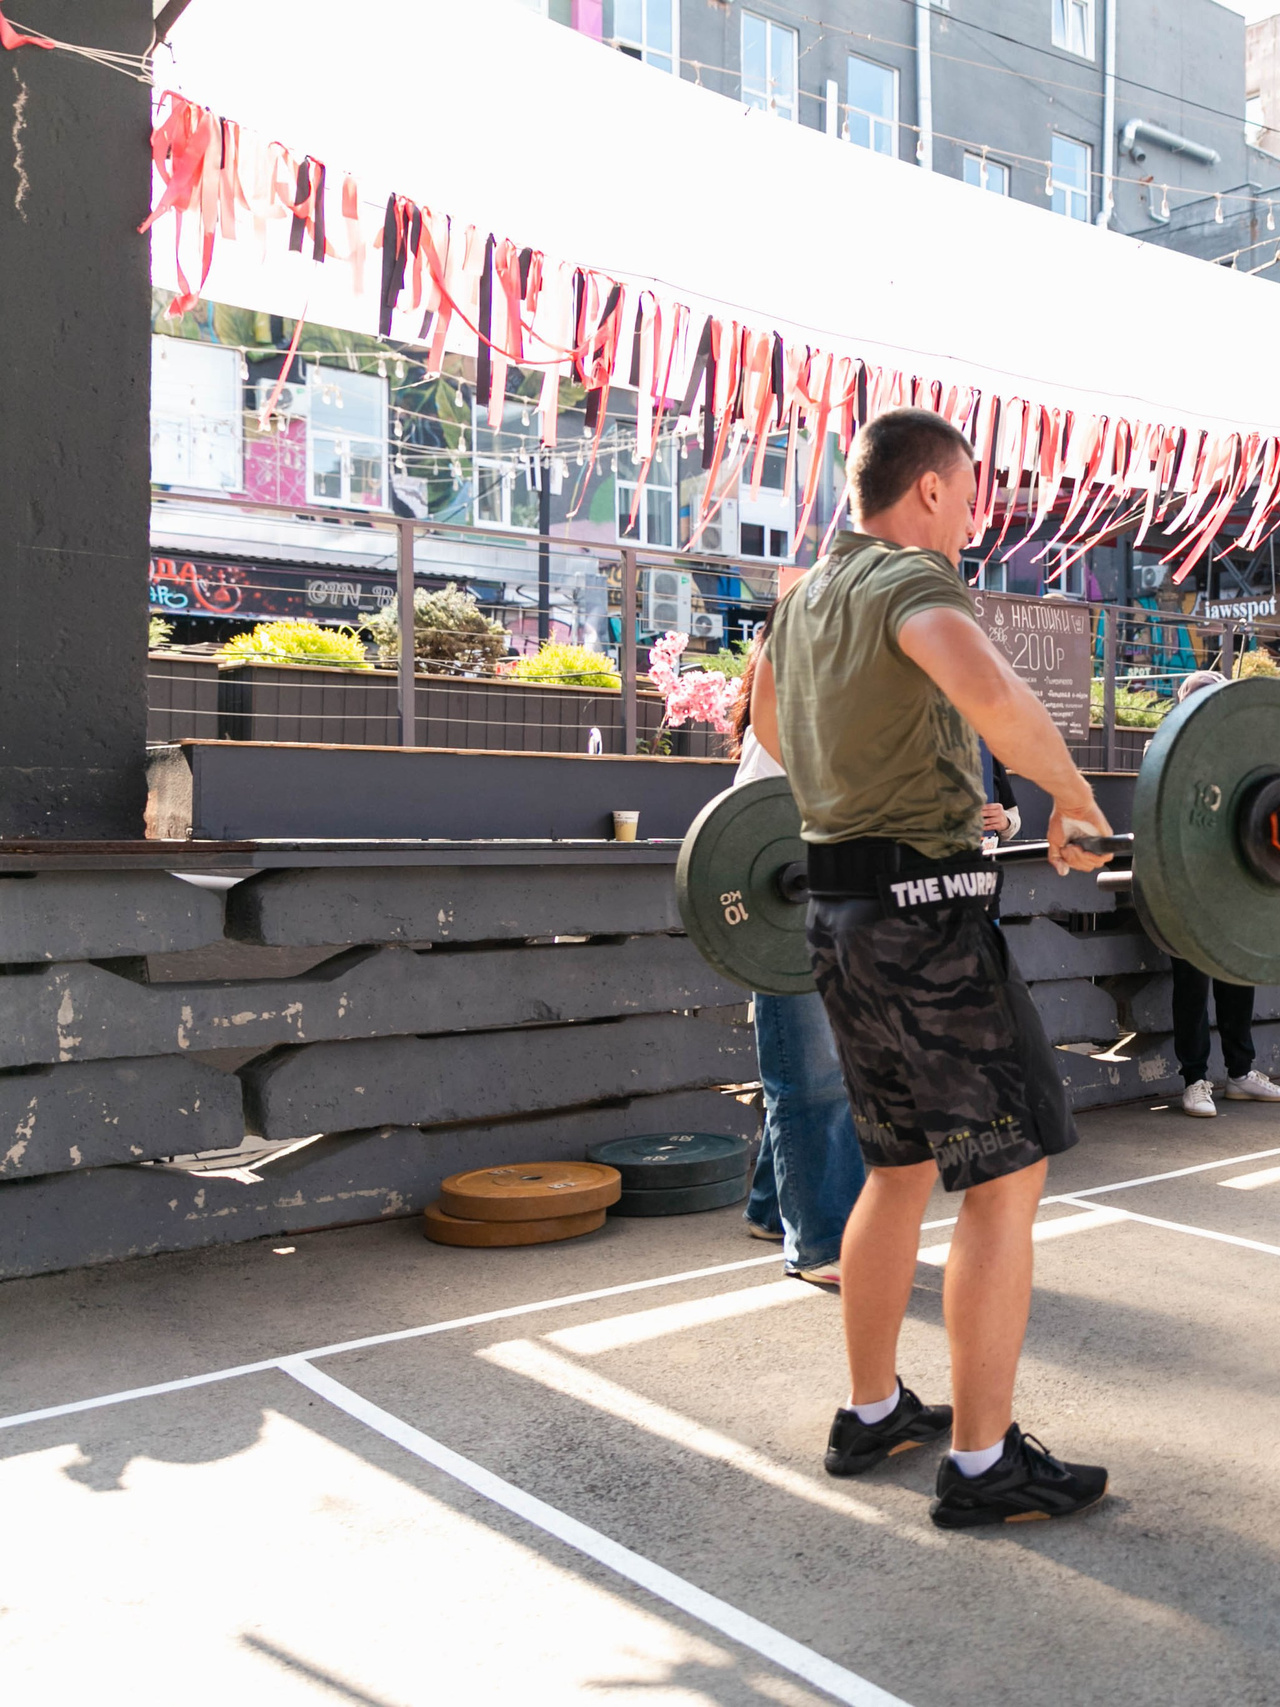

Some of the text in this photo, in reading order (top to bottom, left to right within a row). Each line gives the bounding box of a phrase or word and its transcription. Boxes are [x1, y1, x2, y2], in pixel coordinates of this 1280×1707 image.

[1011, 604, 1070, 632] НАСТОЙКИ
[891, 877, 943, 907] THE
[724, 902, 749, 926] 10
